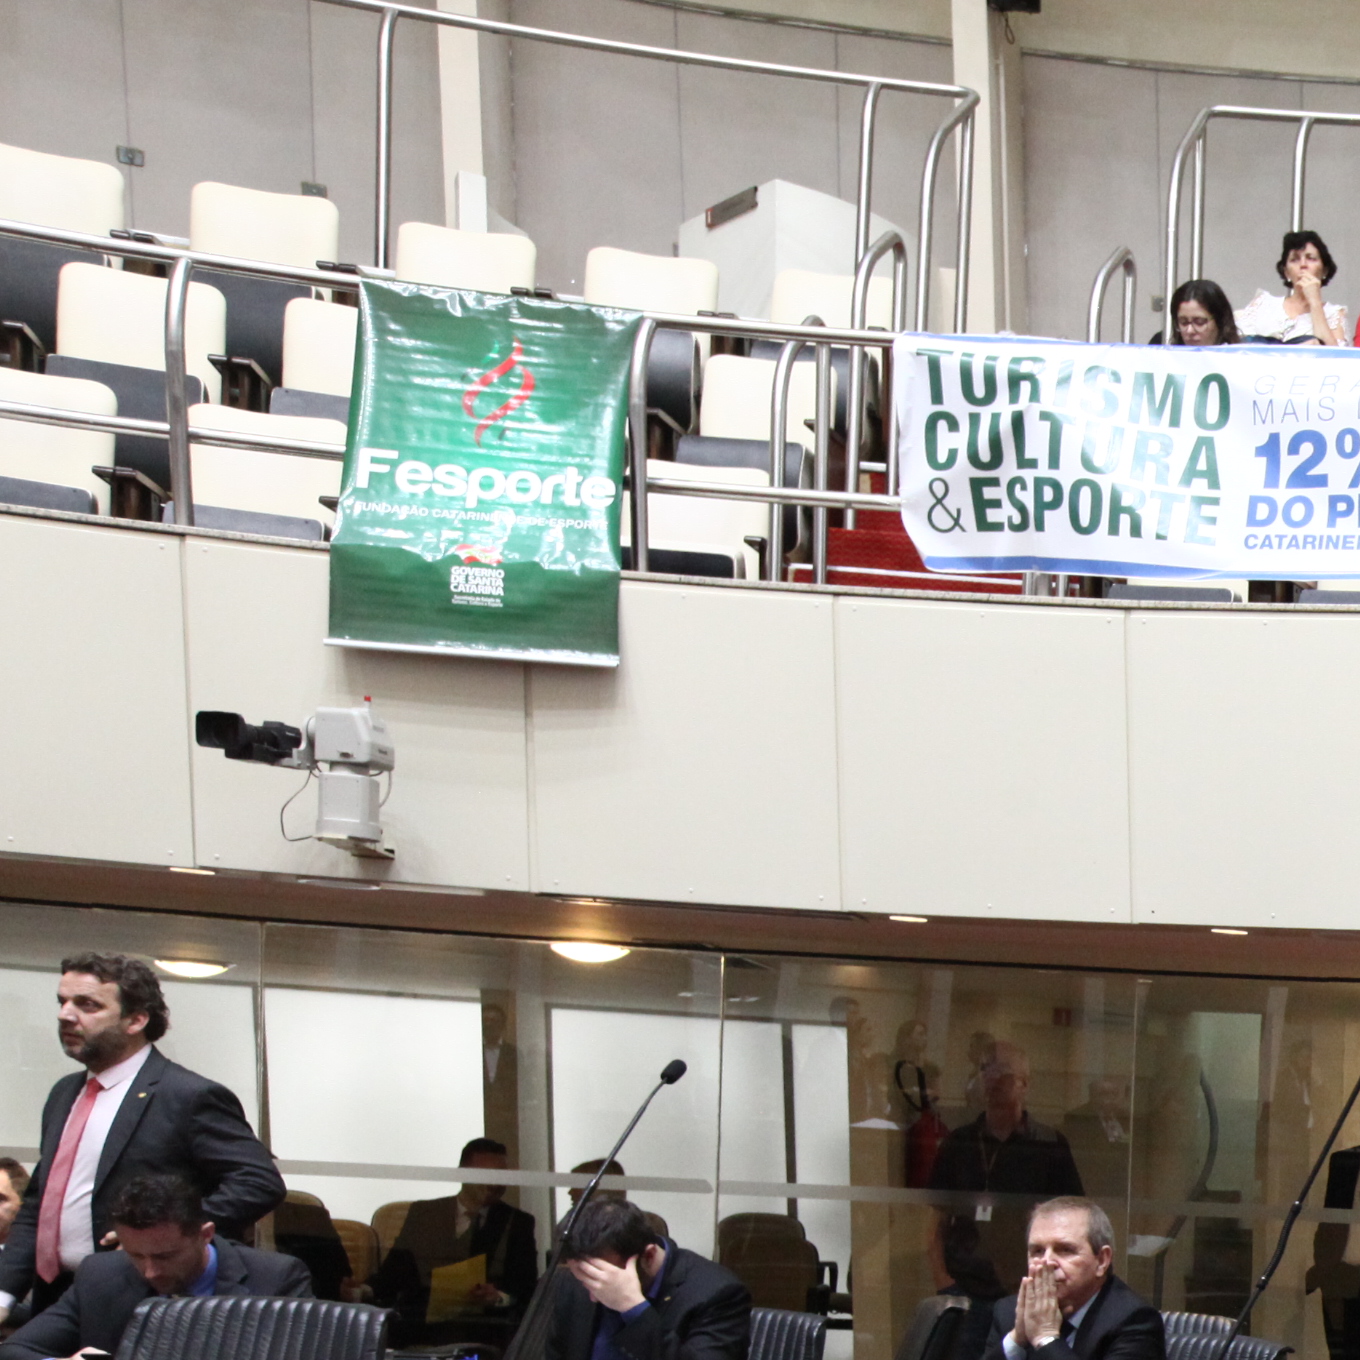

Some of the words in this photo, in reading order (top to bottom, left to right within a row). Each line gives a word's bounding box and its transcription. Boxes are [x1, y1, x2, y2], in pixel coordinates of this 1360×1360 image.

[916, 348, 1231, 431] TURISMO
[1252, 397, 1336, 426] MAIS
[924, 410, 1221, 491] CULTURA
[356, 447, 616, 509] Fesporte
[927, 477, 966, 533] &
[969, 476, 1221, 546] ESPORTE
[1245, 495, 1315, 529] DO
[450, 575, 466, 584] DE
[468, 575, 504, 587] SANTA
[451, 566, 505, 578] GOVERNO
[450, 584, 504, 596] CATARINA
